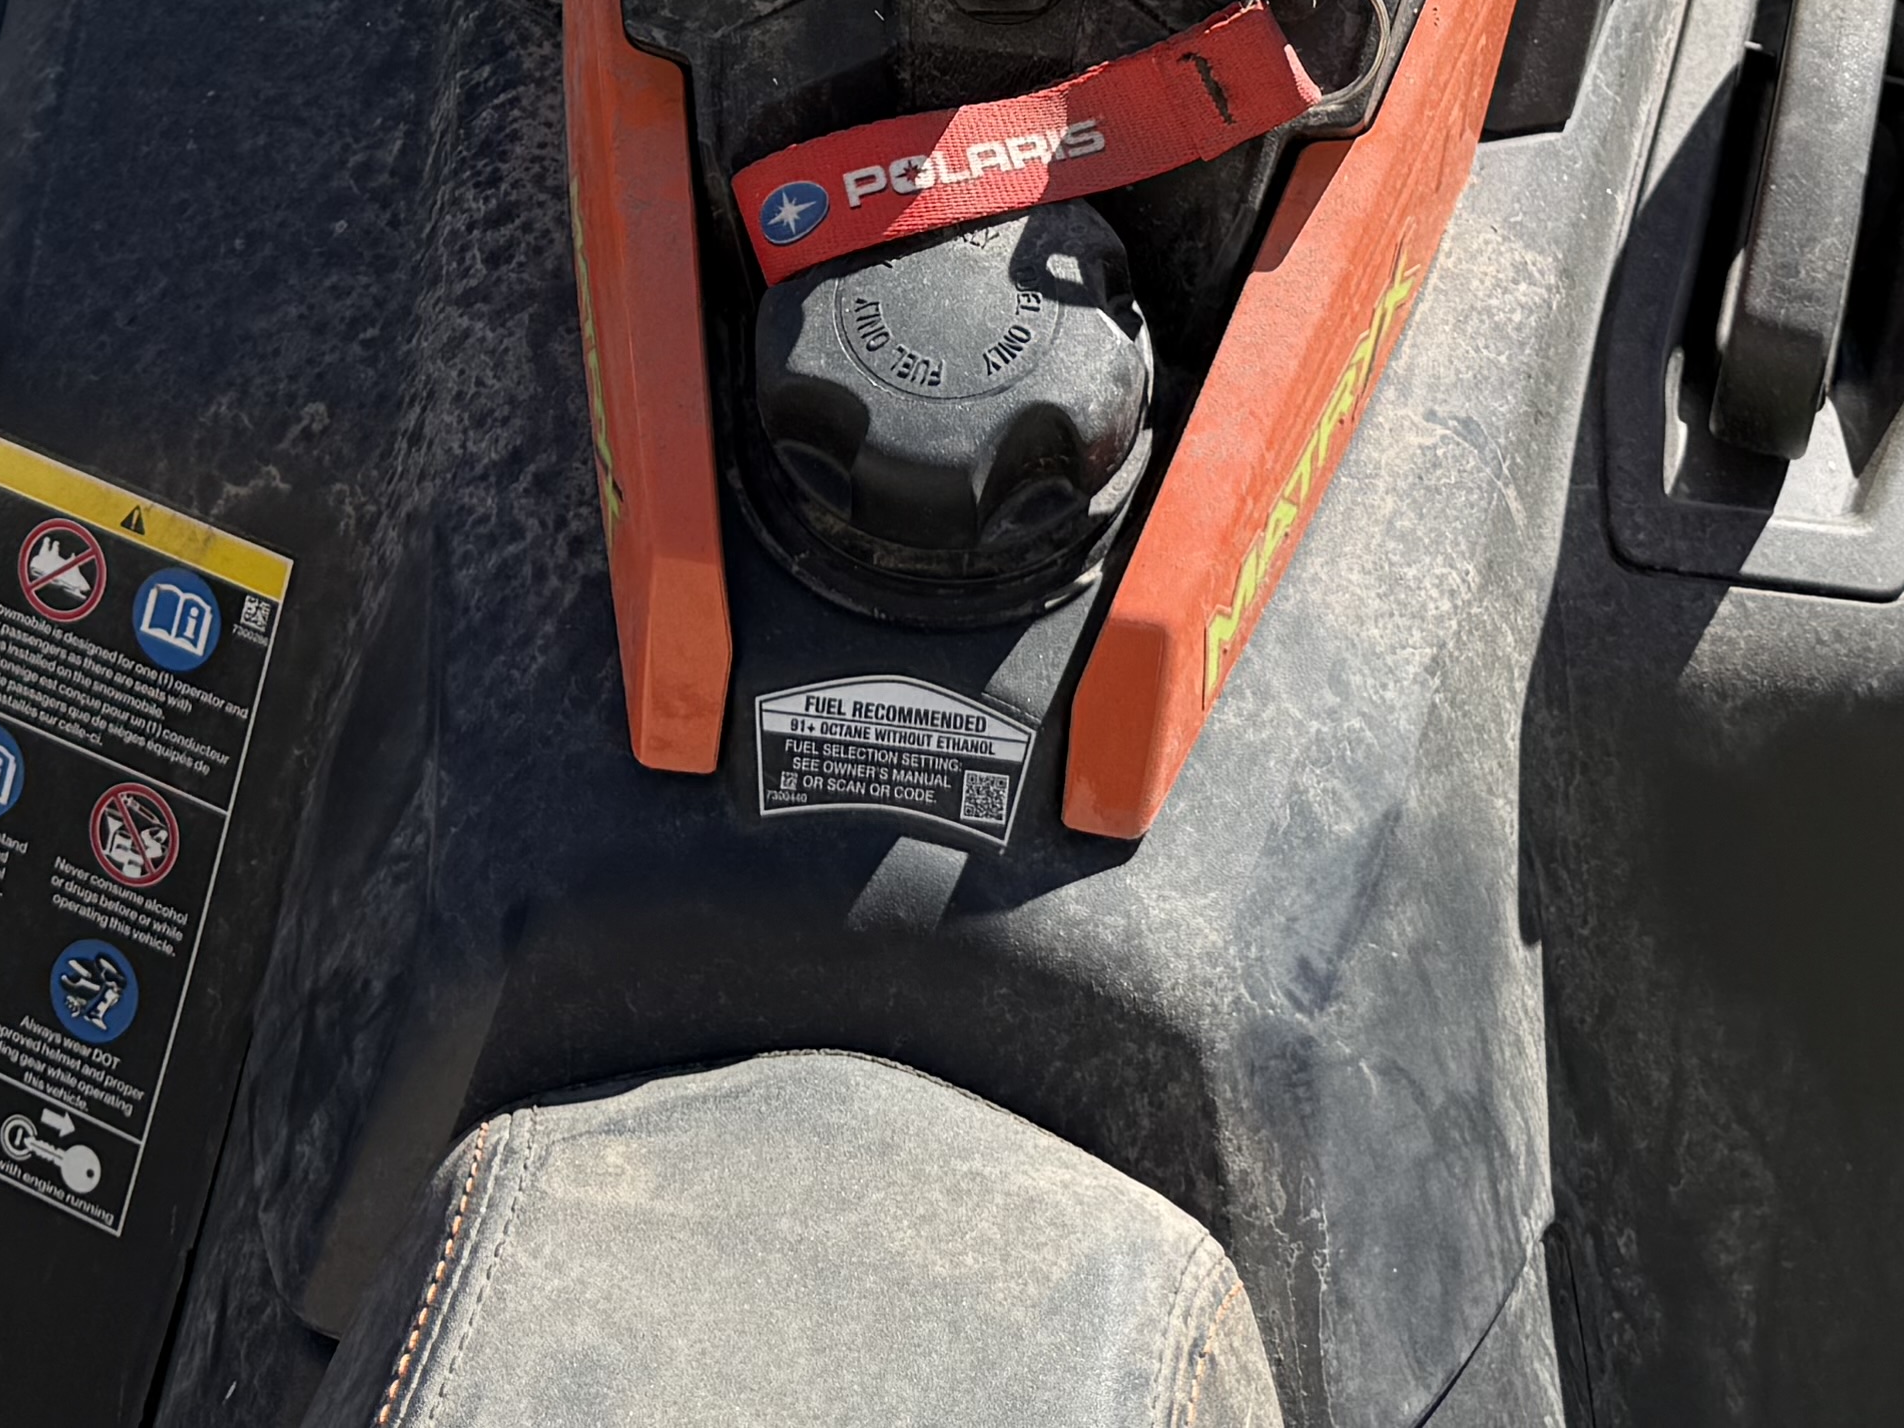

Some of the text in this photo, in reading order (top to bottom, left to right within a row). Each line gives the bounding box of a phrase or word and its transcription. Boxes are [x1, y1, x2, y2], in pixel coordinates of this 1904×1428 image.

[843, 115, 1105, 208] POLARIS
[891, 345, 944, 386] FUEL
[982, 324, 1033, 377] ONLY
[0, 623, 67, 662] passengers
[67, 652, 82, 667] as
[82, 656, 114, 680] there
[113, 671, 134, 689] are
[133, 678, 167, 703] seats
[166, 692, 193, 714] with
[7, 640, 57, 672] installed
[55, 664, 72, 679] on
[72, 669, 93, 687] the
[91, 676, 167, 720] snowmobile.
[51, 625, 63, 639] is
[62, 629, 117, 665] designed
[117, 652, 136, 671] for
[134, 662, 158, 681] one
[172, 677, 225, 712] operator
[224, 699, 249, 720] and
[805, 695, 987, 733] FUEL RECOMMENDED
[820, 722, 871, 740] OCTANE
[875, 727, 933, 748] WITHOUT
[936, 736, 996, 756] ETHANOL
[785, 739, 963, 772] FUEL SELECTION SETTING:
[792, 757, 952, 789] SEE OWNER'S MANUAL
[803, 775, 824, 790] OR
[827, 778, 866, 795] SCAN
[870, 783, 891, 799] QR
[50, 872, 184, 942] or drugs before or while
[51, 889, 109, 930] operating
[108, 915, 132, 936] this
[54, 855, 188, 926] Never consume alcohol
[19, 1013, 120, 1071] Always wear DOT
[18, 1051, 47, 1077] gear
[46, 1063, 78, 1088] while
[76, 1077, 134, 1118] operating
[23, 1070, 45, 1090] this
[40, 1041, 81, 1071] helmet
[80, 1060, 105, 1083] and
[103, 1073, 144, 1103] proper
[21, 1168, 66, 1202] engine
[64, 1190, 114, 1226] running
